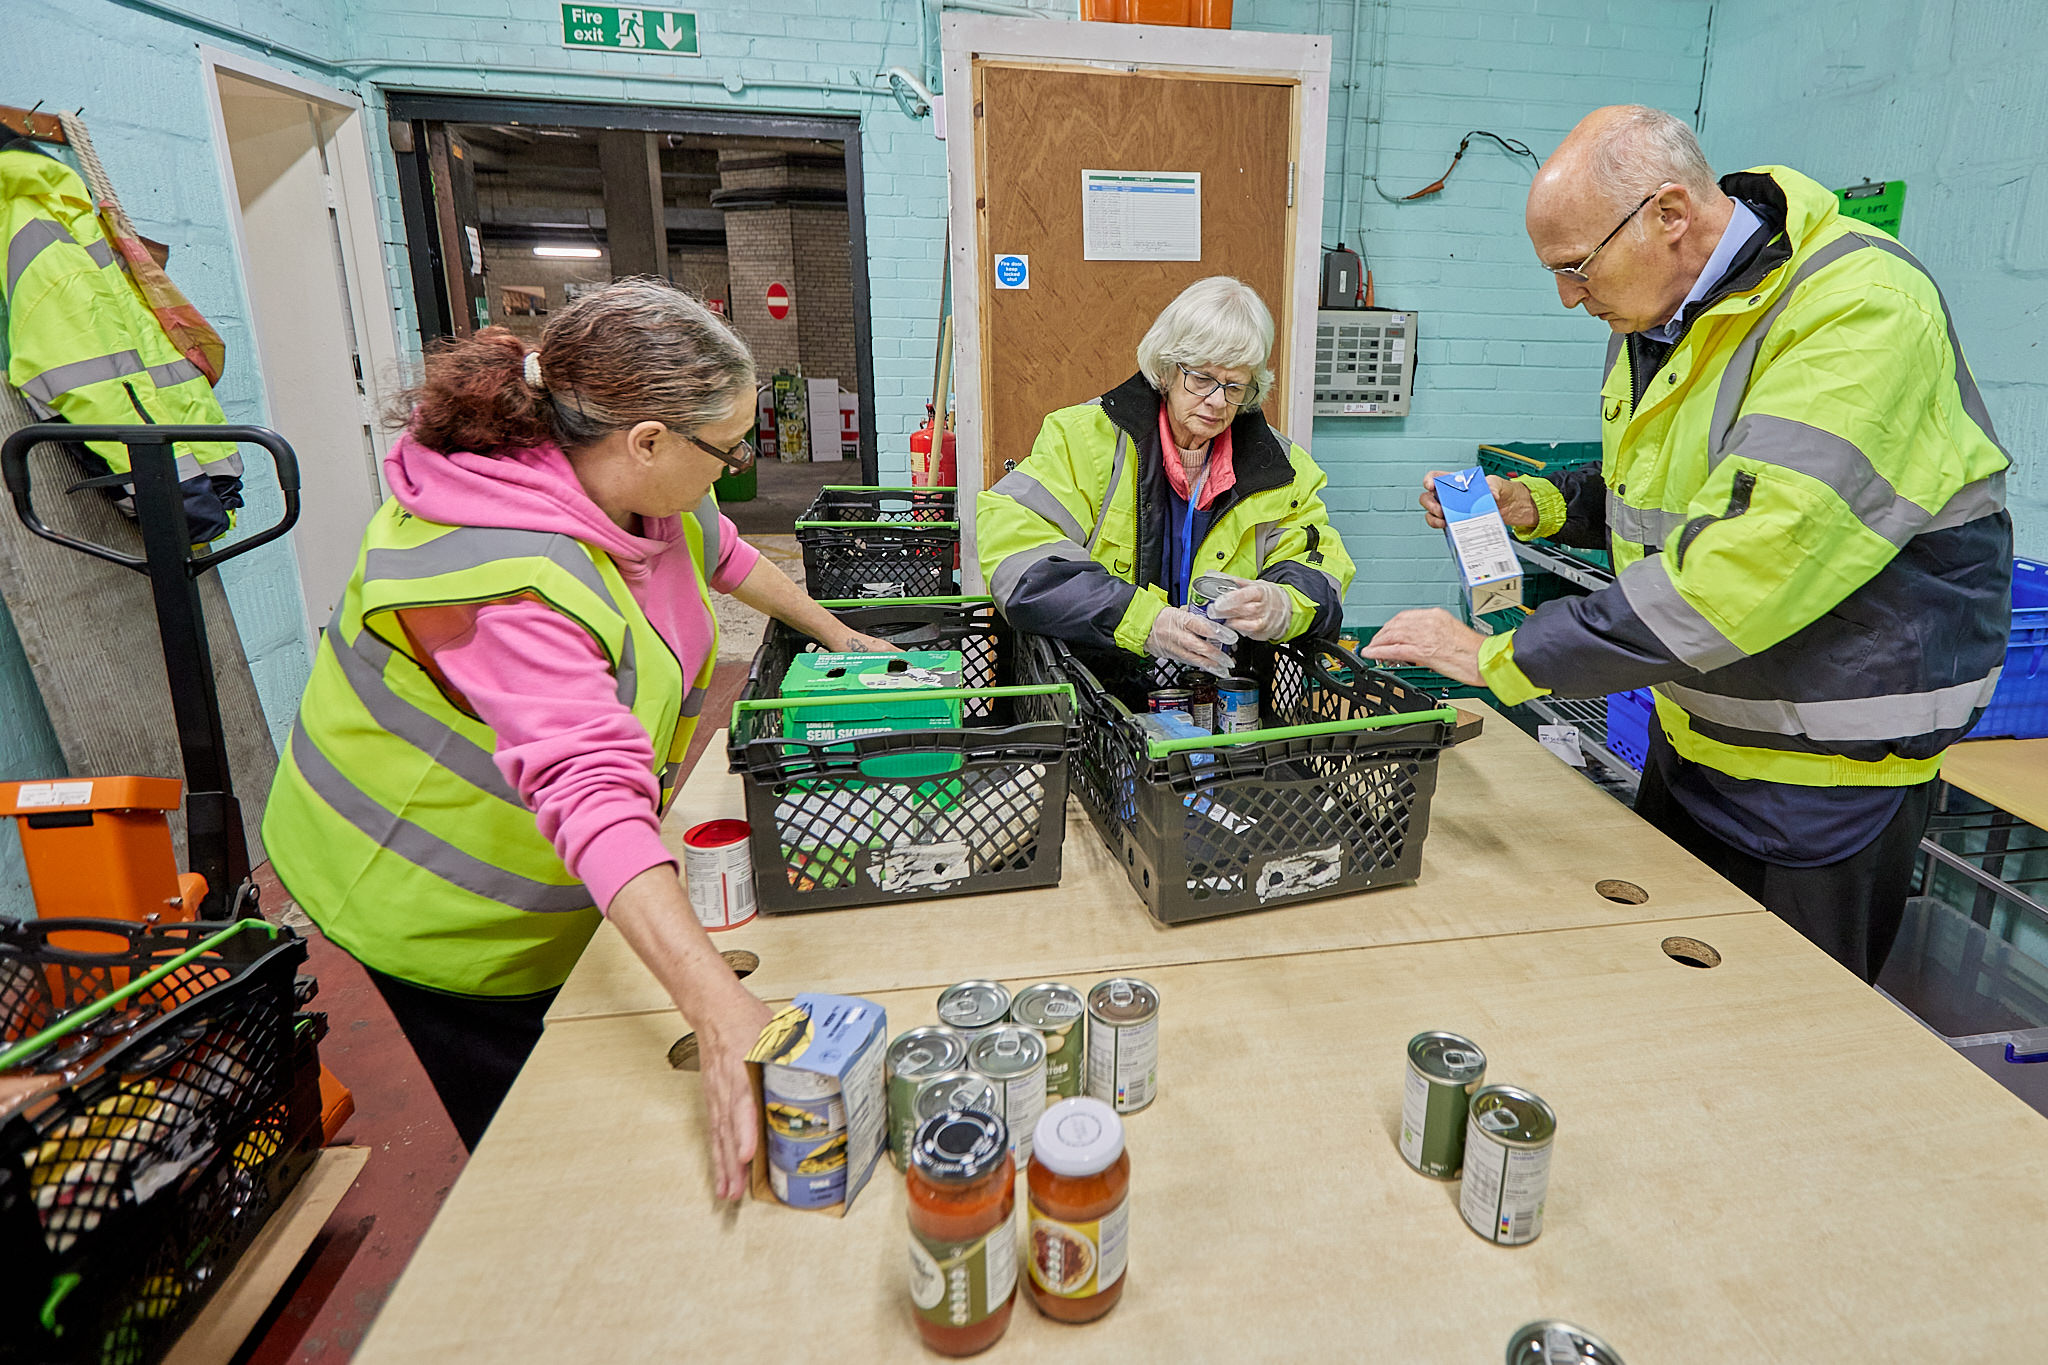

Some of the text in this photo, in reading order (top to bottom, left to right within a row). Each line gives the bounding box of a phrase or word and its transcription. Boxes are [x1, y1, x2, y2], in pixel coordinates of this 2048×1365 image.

[571, 8, 603, 25] Fire
[573, 27, 604, 42] exit
[806, 729, 836, 741] SEMI
